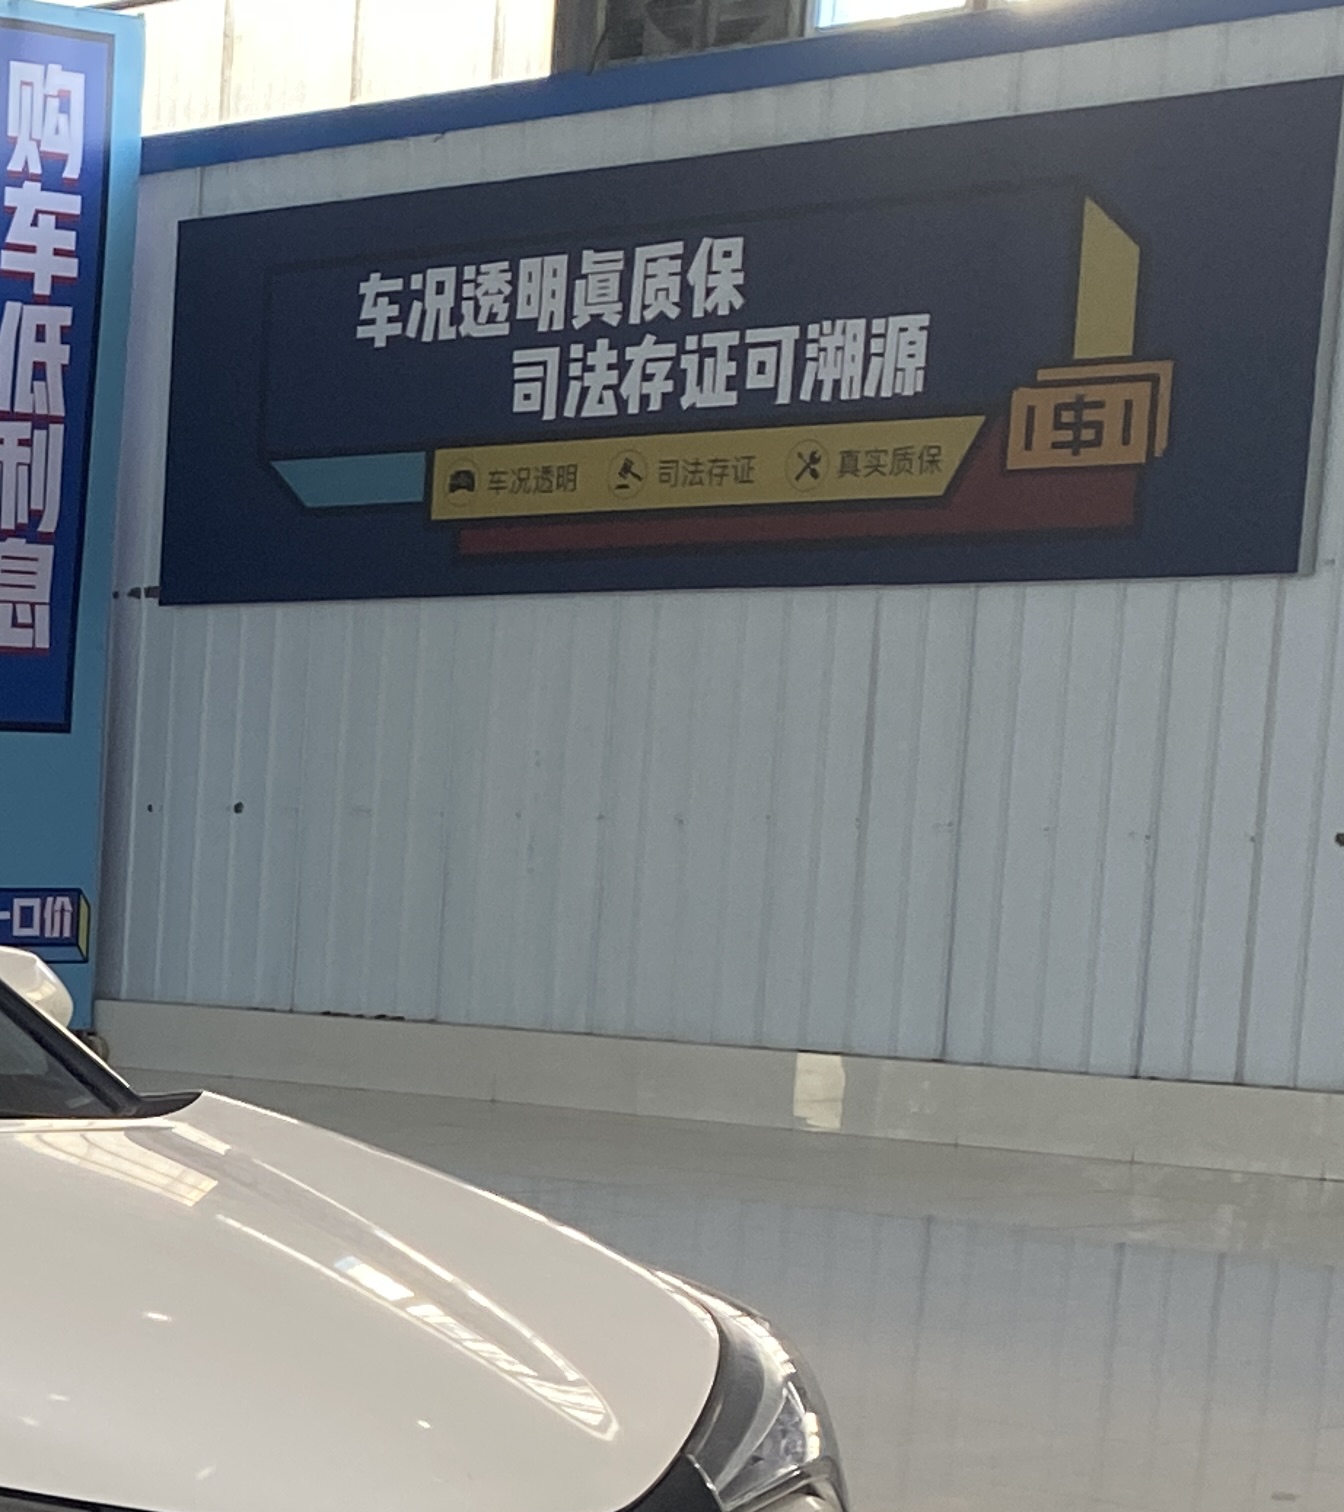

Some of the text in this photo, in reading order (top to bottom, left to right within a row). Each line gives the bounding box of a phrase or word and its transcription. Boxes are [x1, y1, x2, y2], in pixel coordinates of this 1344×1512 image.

[511, 313, 931, 421] 司法存证可溯源
[487, 445, 944, 495] 车况透明 司法存证 真实质保
